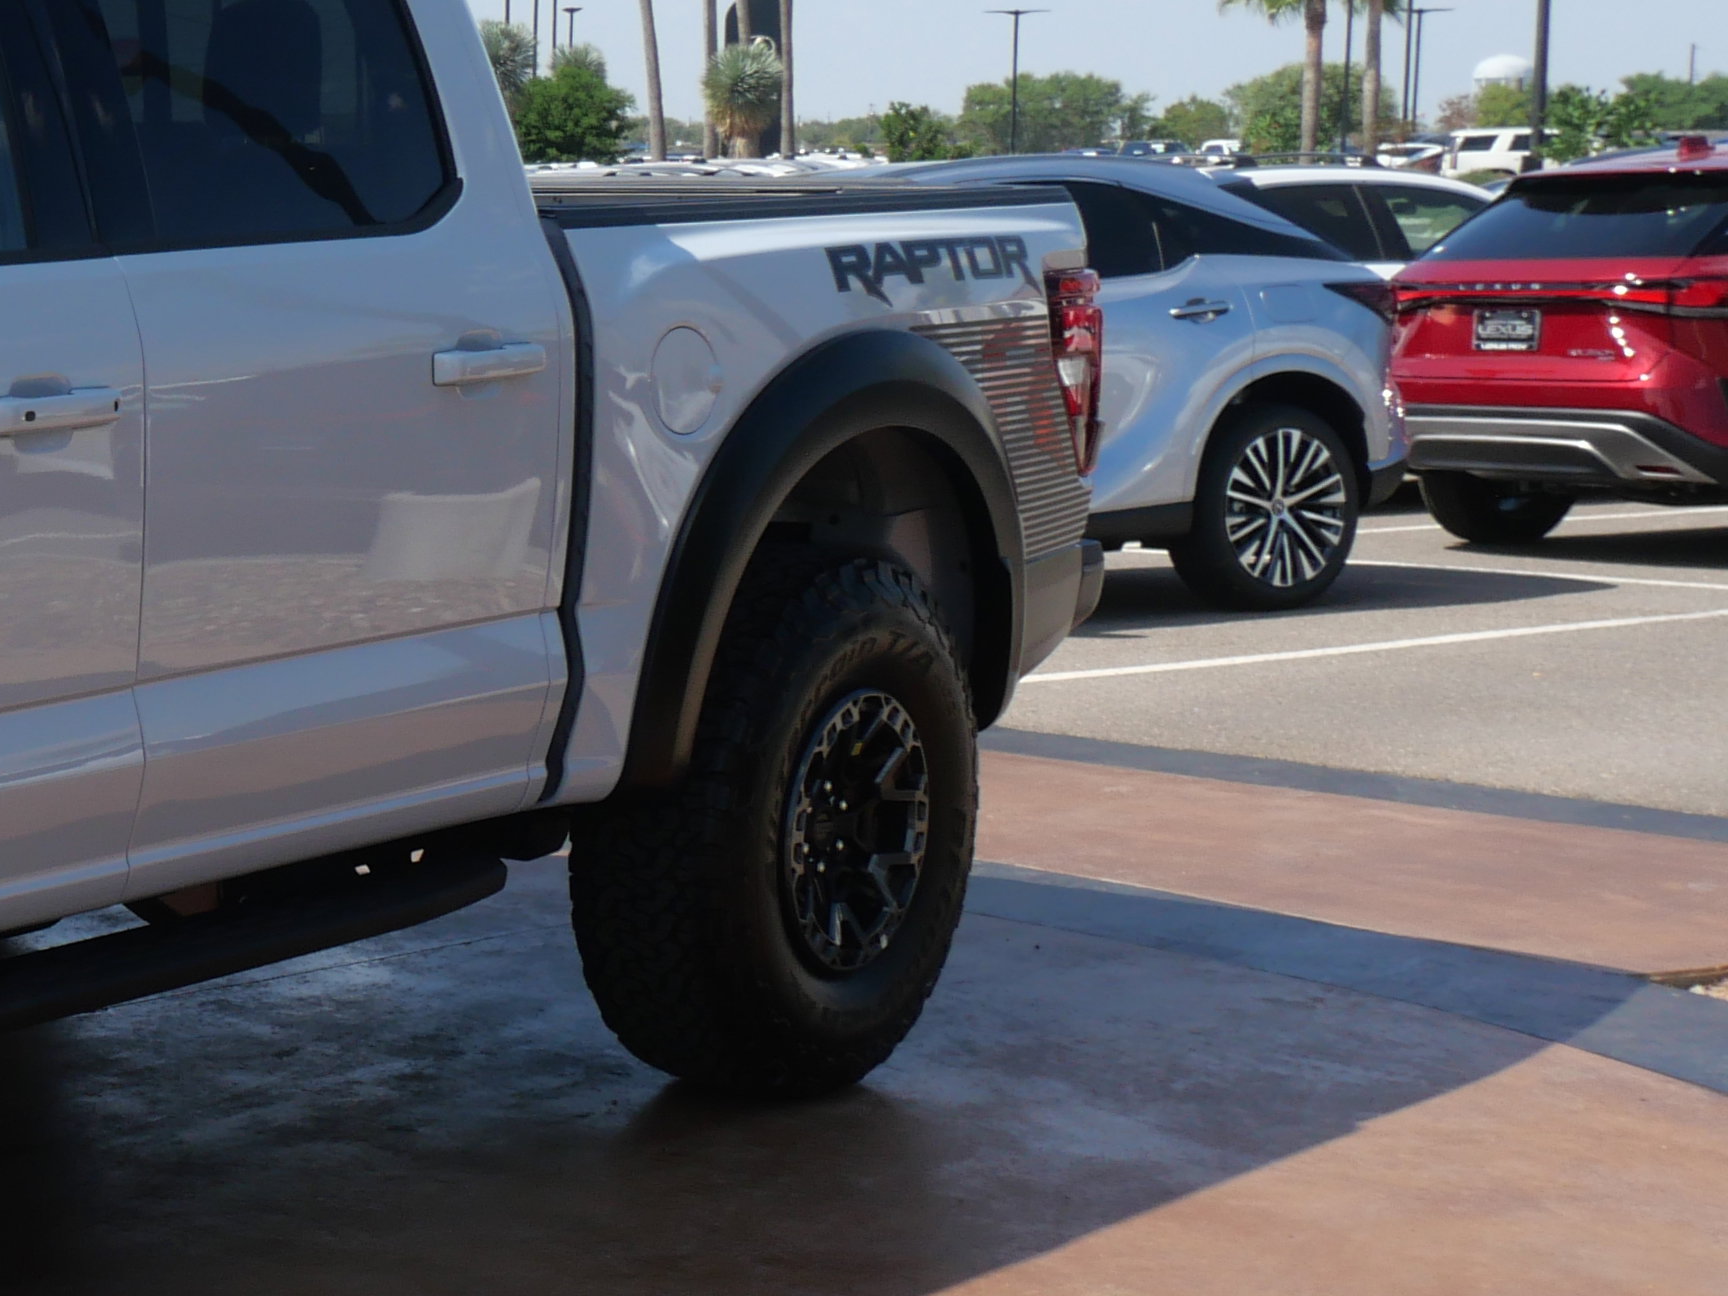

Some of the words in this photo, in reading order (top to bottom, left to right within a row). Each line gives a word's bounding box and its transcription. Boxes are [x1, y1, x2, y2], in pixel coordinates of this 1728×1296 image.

[824, 235, 1042, 308] RAPTOR
[1458, 283, 1540, 291] LEXUS
[1477, 323, 1534, 336] LEXUS
